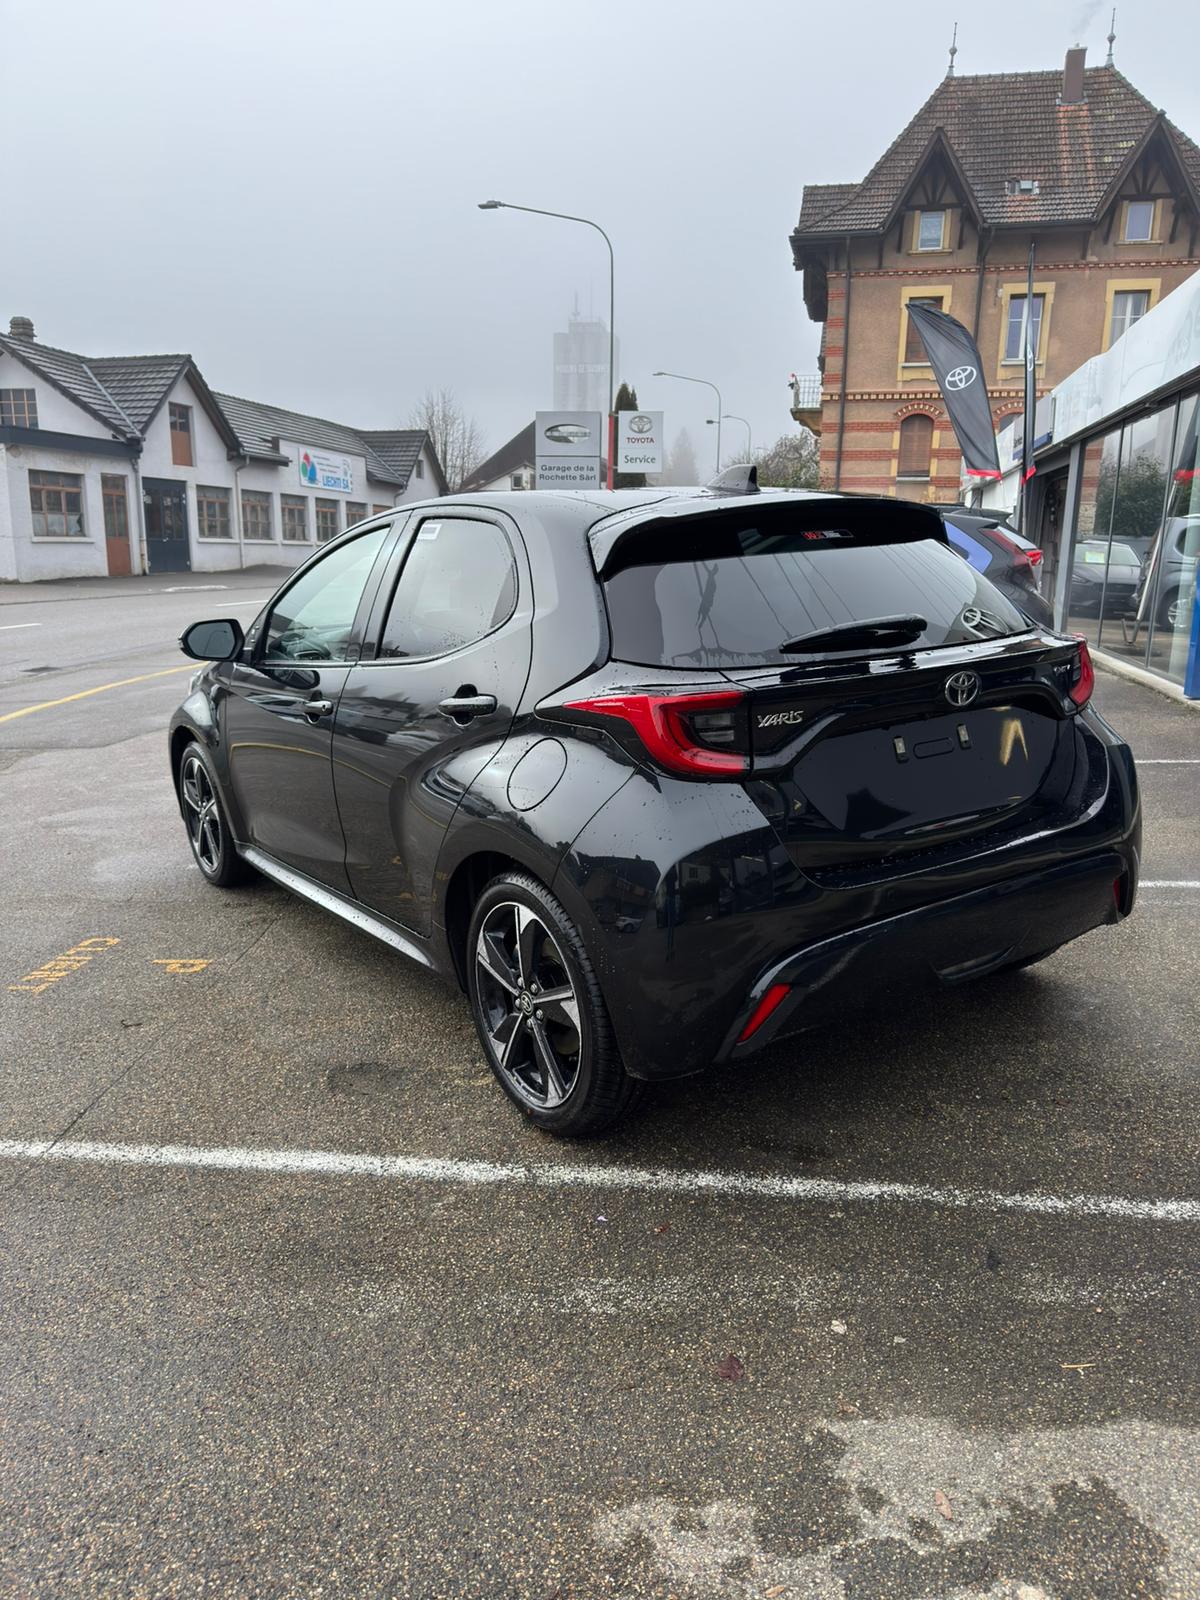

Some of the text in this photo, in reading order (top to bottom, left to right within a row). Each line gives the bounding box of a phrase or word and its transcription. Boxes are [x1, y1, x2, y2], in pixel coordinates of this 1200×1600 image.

[624, 455, 656, 464] Service
[540, 464, 595, 473] Garage de la
[539, 473, 578, 481] Rochette
